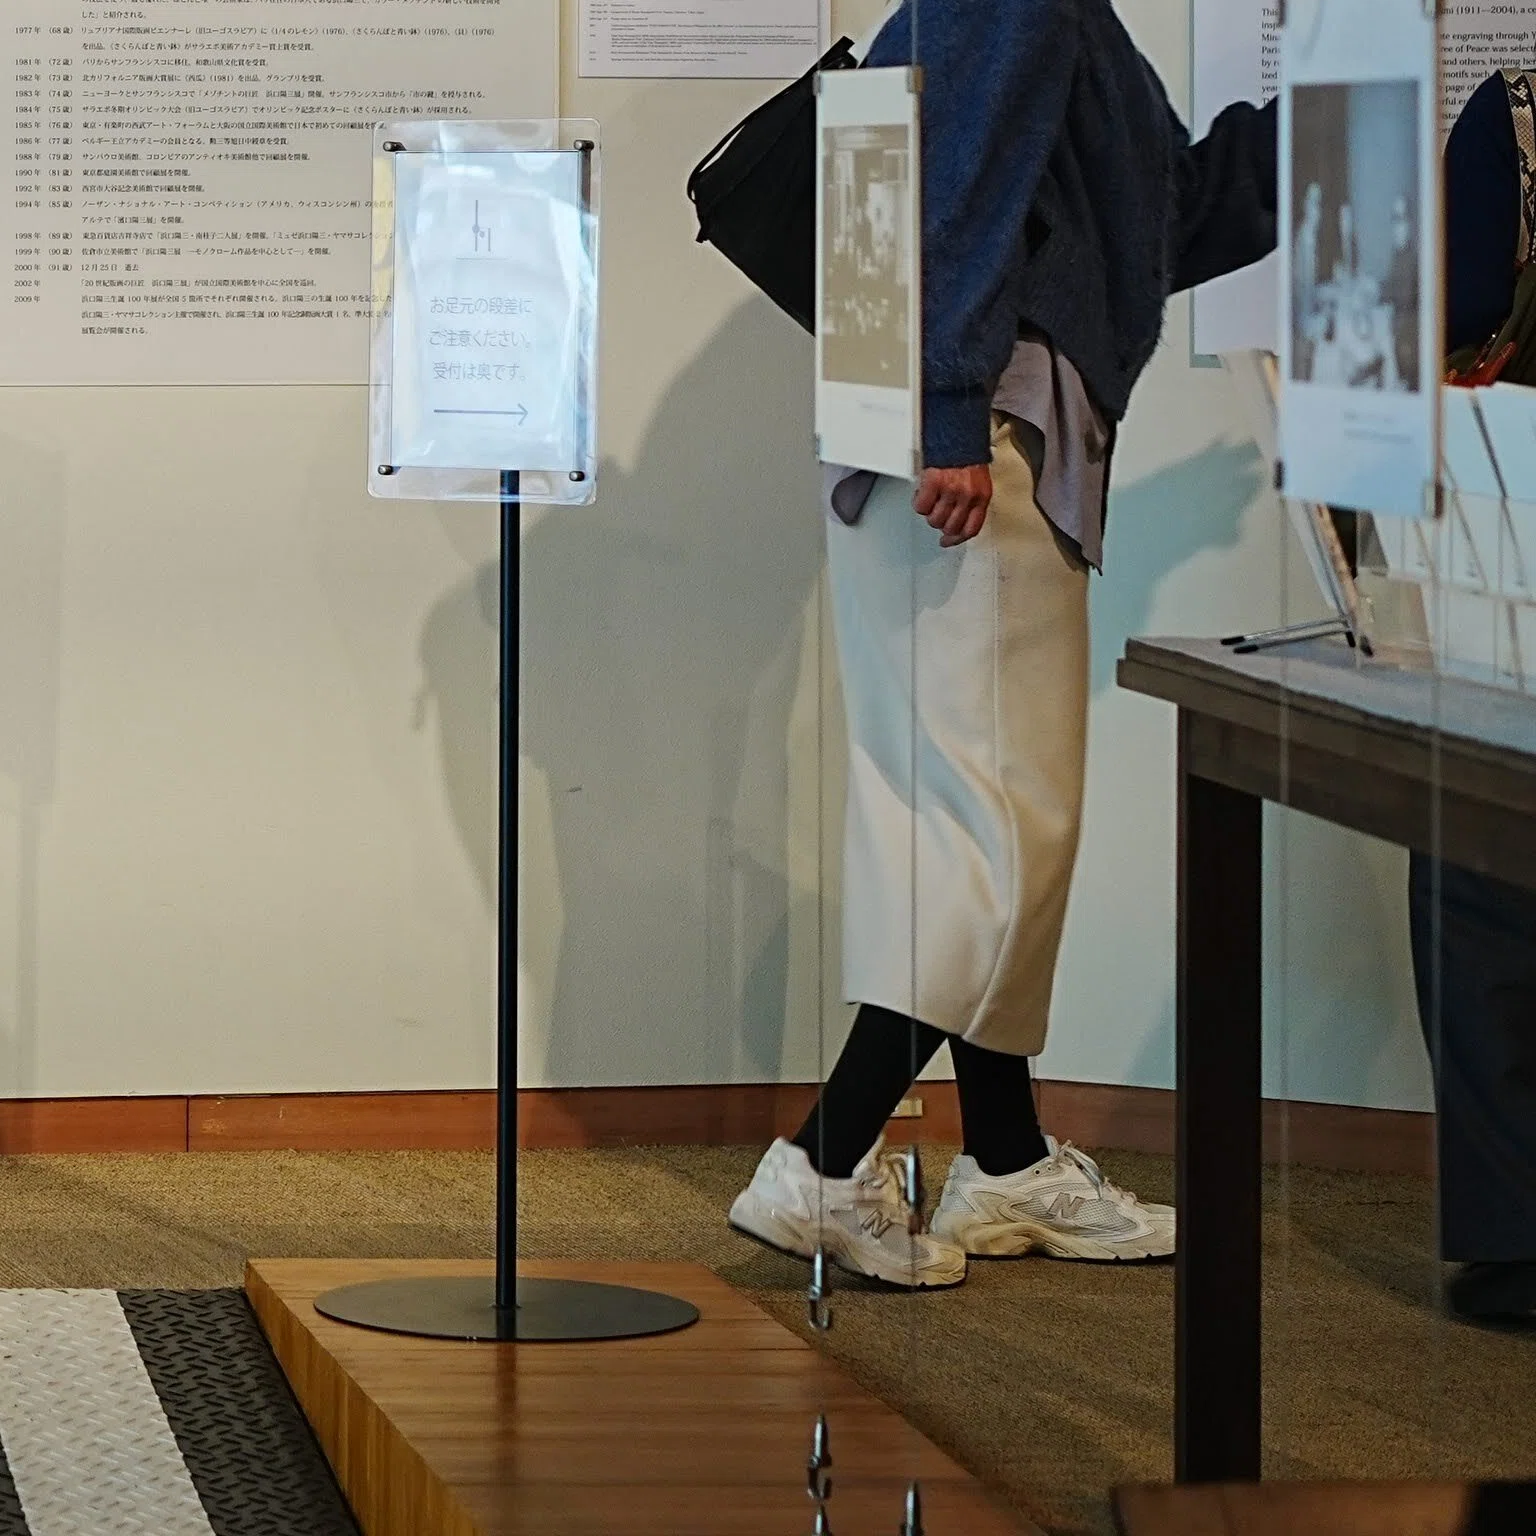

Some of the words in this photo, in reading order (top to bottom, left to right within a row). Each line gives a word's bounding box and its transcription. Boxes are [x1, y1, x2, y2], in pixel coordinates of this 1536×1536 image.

[81, 11, 147, 21] した」と紹介される。
[14, 26, 41, 35] 1977年
[1452, 32, 1494, 43] engraving
[1495, 32, 1529, 43] through
[1455, 44, 1465, 53] of
[1465, 44, 1490, 53] Peace
[1492, 45, 1508, 53] was
[14, 58, 41, 67] 1981年
[1261, 58, 1272, 67] by
[1489, 57, 1521, 68] helping
[14, 73, 41, 83] 1982年
[1442, 70, 1469, 79] motifs
[1470, 69, 1490, 79] such
[1445, 83, 1465, 93] page
[1467, 82, 1477, 91] of
[14, 90, 41, 98] 1983年
[14, 105, 41, 114] 1984年
[14, 121, 41, 130] 1985年
[14, 137, 41, 146] 1986年
[14, 153, 41, 162] 1988年
[14, 168, 41, 178] 1990年
[14, 184, 41, 194] 1992年
[14, 200, 41, 209] 1994年
[14, 231, 41, 241] 1998年
[14, 247, 41, 257] 1999年
[14, 264, 41, 273] 2000年
[14, 279, 41, 289] 2002年
[14, 295, 41, 305] 2009年
[429, 296, 533, 315] お足元の段差に
[81, 326, 148, 336] 展覧会が開催される。
[428, 329, 531, 349] ご注意ください。
[432, 360, 527, 380] 受付は奥です。
